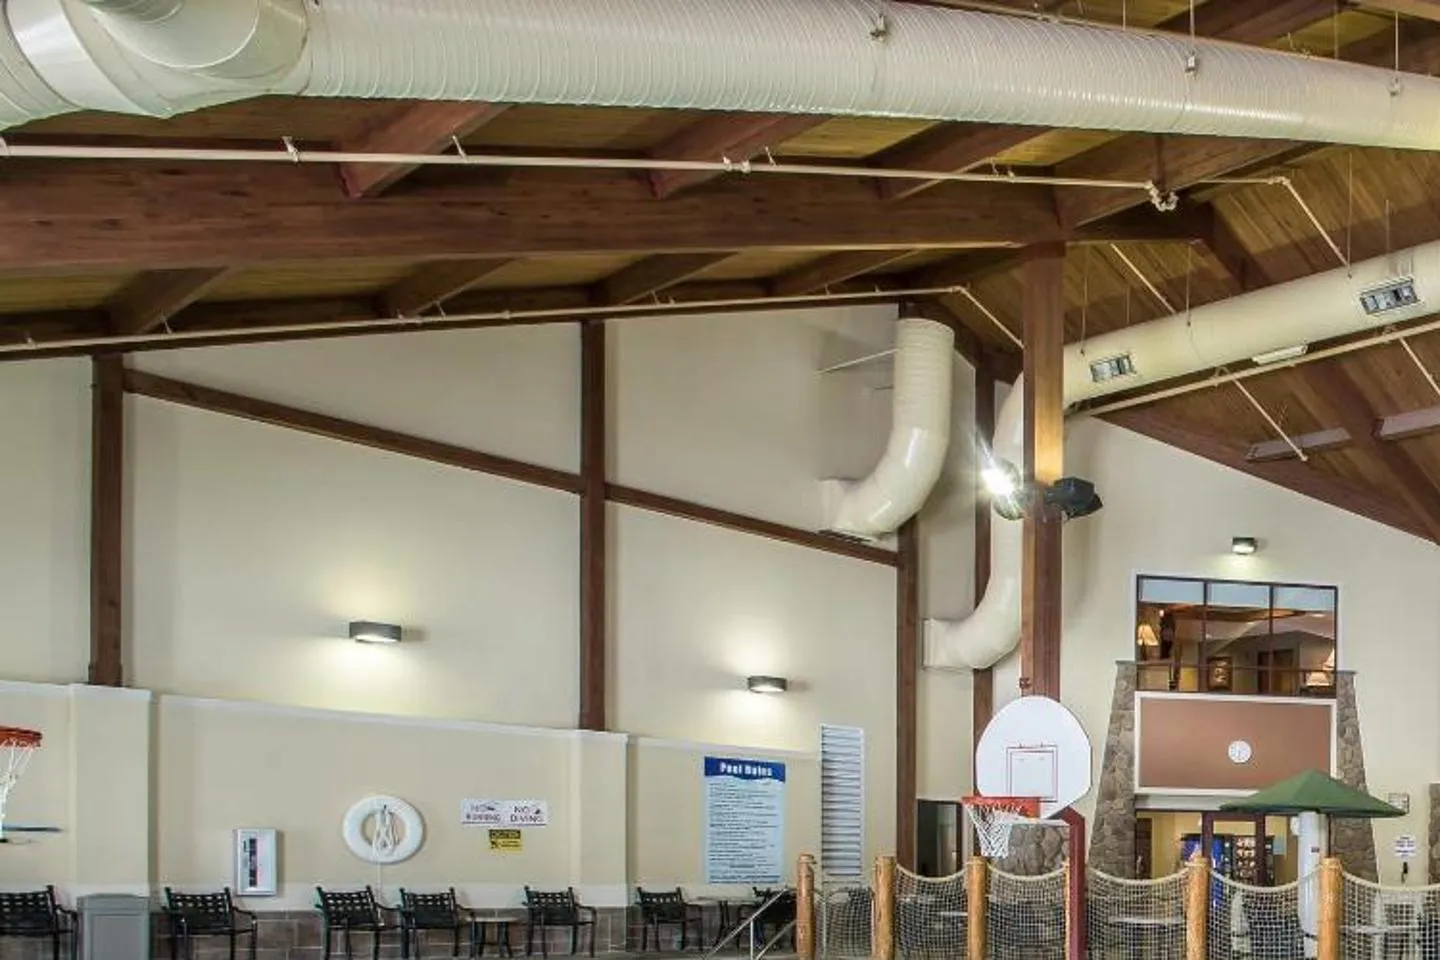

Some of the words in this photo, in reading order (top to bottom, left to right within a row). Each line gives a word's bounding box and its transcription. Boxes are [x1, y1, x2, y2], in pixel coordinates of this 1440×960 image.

[719, 762, 742, 774] Pool
[744, 764, 772, 777] Rules
[513, 805, 530, 814] NO
[510, 813, 544, 823] DIVING
